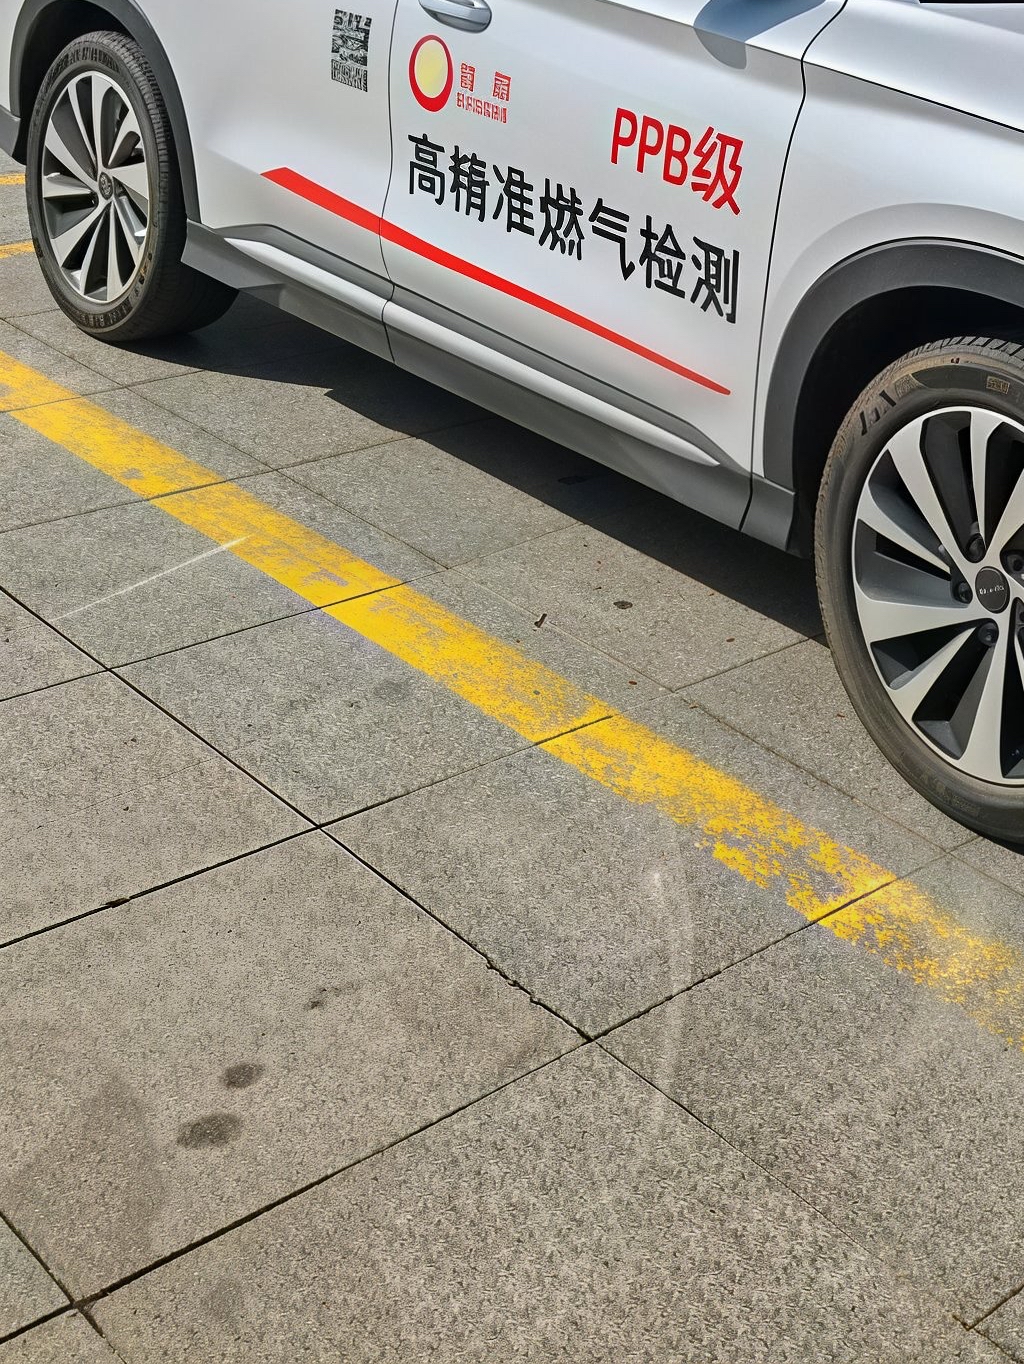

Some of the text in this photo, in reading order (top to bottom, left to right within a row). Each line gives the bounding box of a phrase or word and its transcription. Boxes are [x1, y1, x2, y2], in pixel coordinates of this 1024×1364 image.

[407, 133, 740, 324] 高精准燃气检测
[610, 107, 744, 216] PPB级
